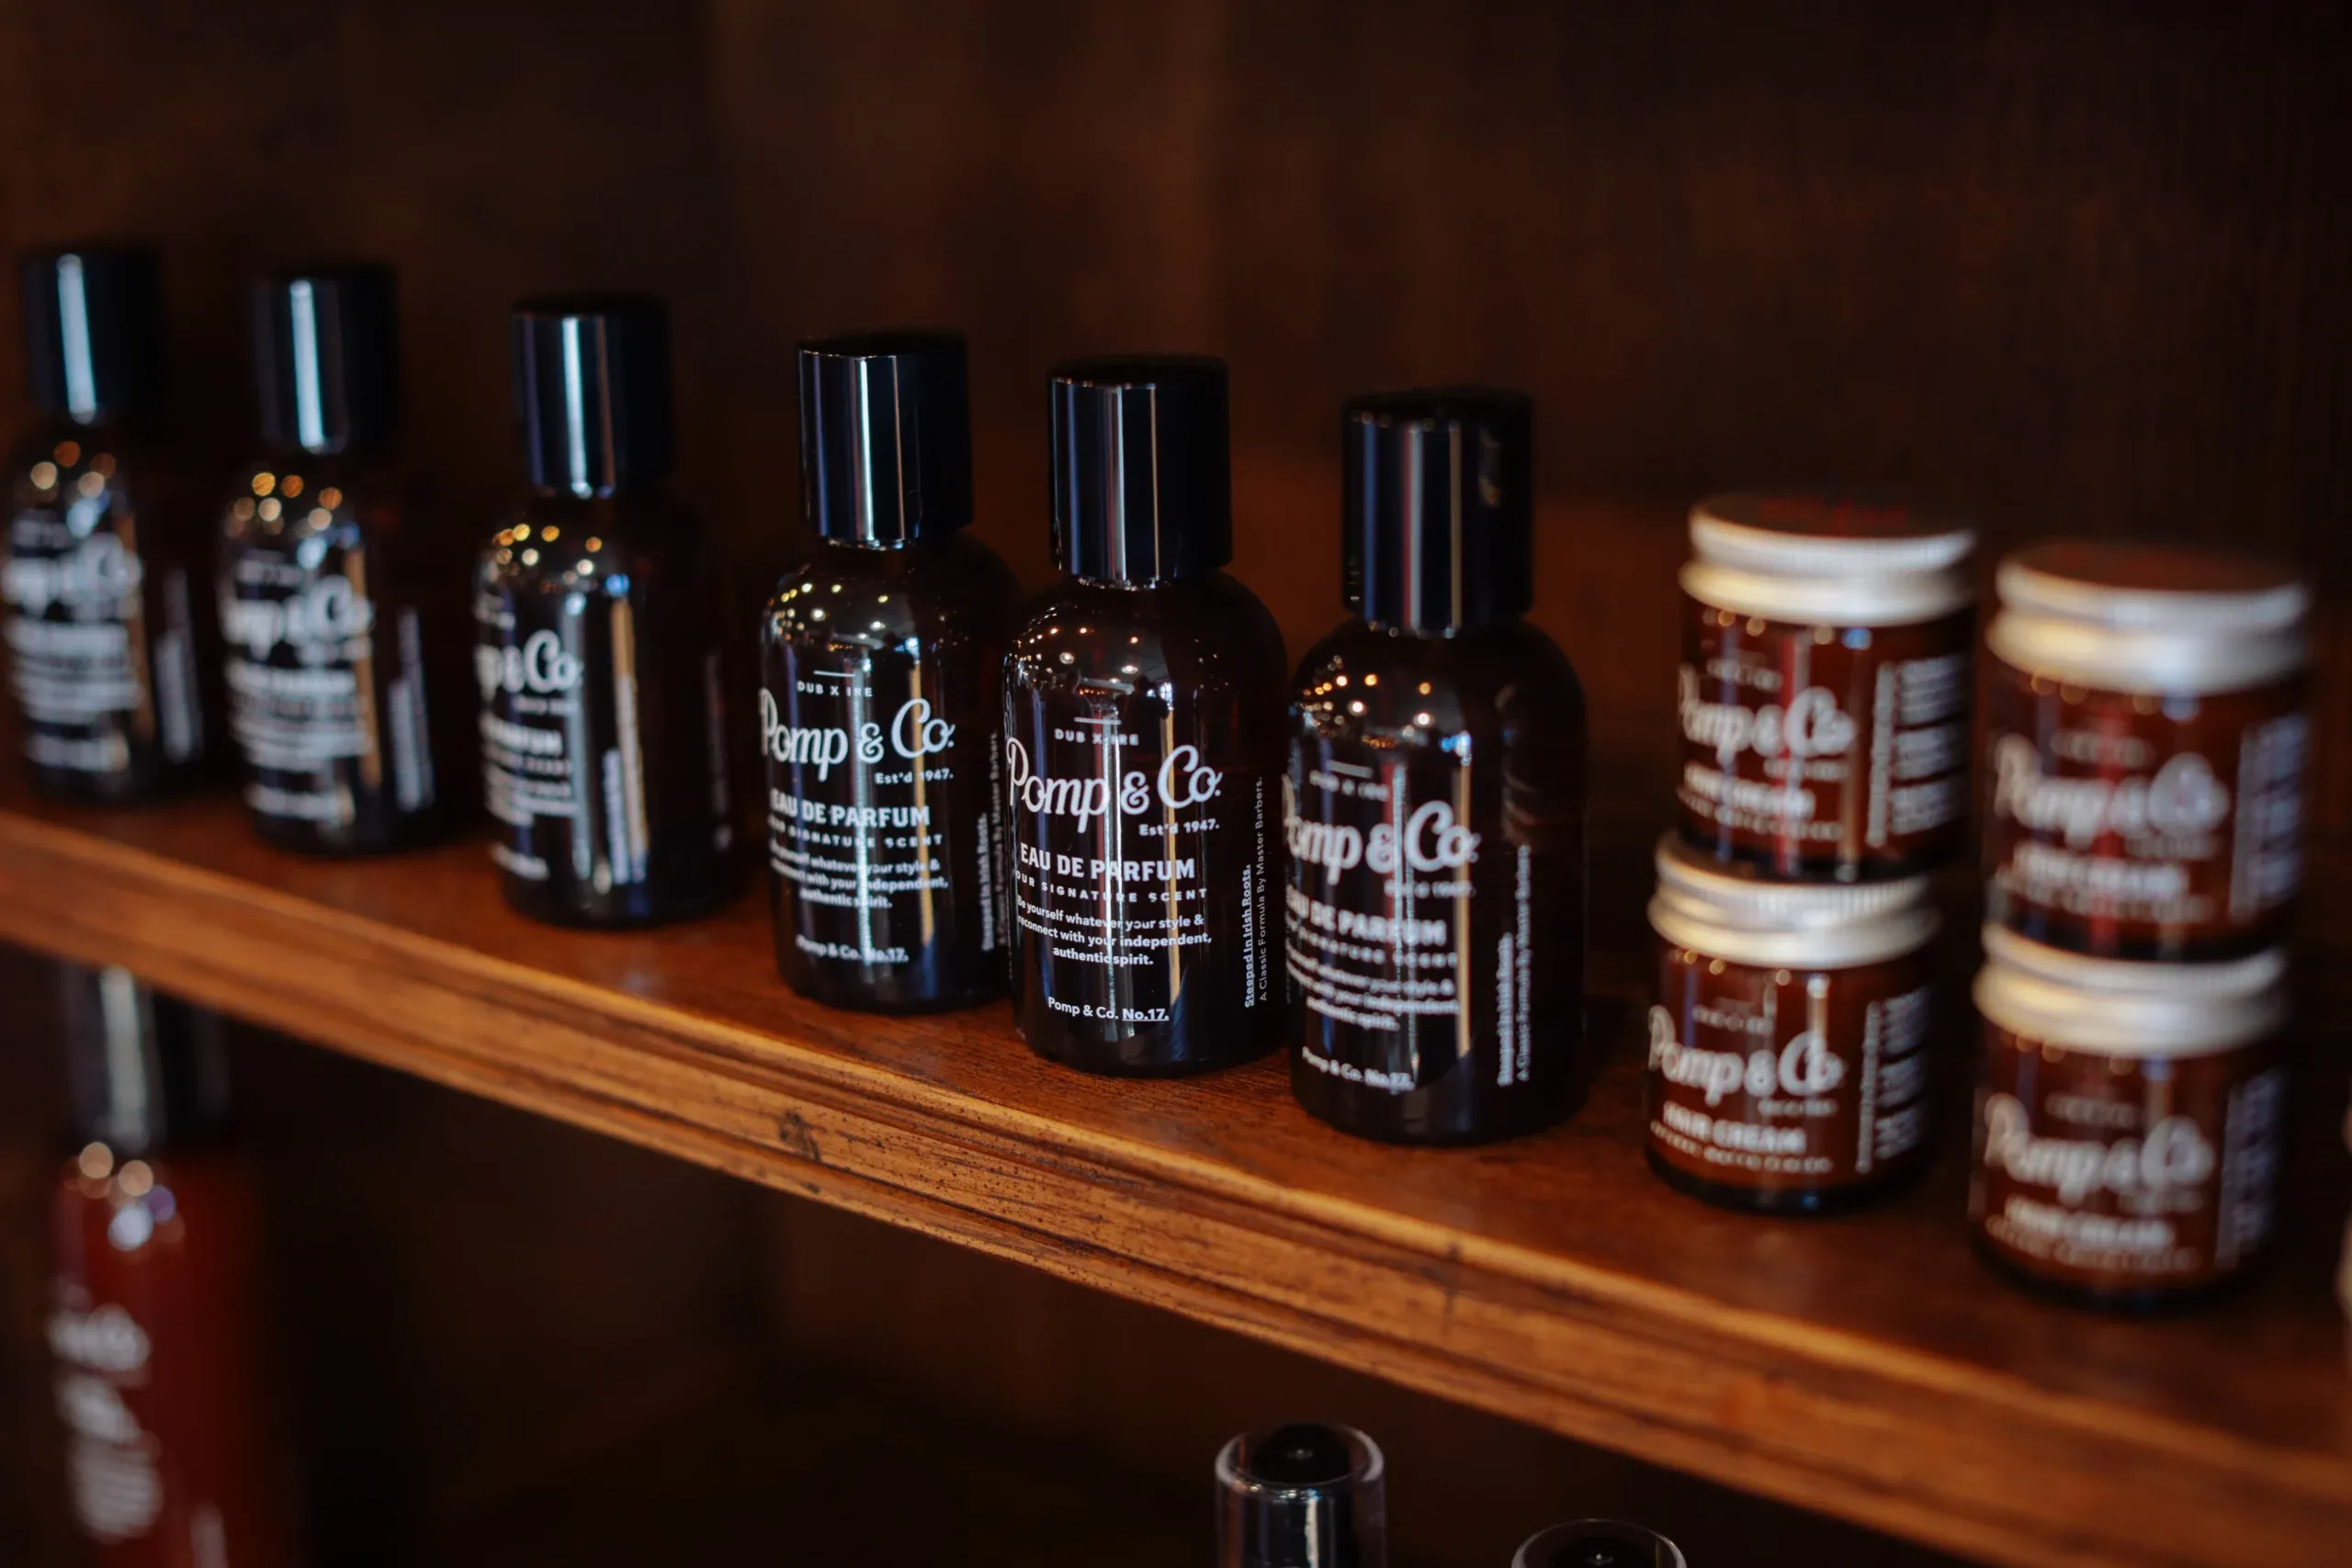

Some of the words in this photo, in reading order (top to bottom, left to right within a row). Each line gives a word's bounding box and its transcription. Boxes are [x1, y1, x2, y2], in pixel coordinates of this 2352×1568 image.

[797, 681, 824, 695] DUB
[830, 686, 840, 696] X
[845, 686, 874, 697] IRE
[759, 687, 848, 782] Pomp
[858, 722, 884, 763] &
[891, 698, 956, 758] Co.
[1055, 728, 1086, 743] DUB
[1092, 734, 1102, 744] X
[1006, 737, 1111, 833] Pomp
[1120, 771, 1150, 816] &
[1157, 744, 1223, 809] Co.
[1255, 775, 1263, 830] Barbers.
[770, 788, 797, 817] EAU
[802, 799, 827, 824] DE
[830, 805, 931, 828] PARFUM
[884, 834, 943, 848] SCENT
[1139, 823, 1179, 837] Est'd
[1183, 818, 1220, 833] 1947.
[929, 858, 940, 871] &
[1021, 841, 1051, 871] EAU
[1057, 853, 1084, 878] DE
[1090, 858, 1195, 882] PARFUM
[1256, 831, 1264, 875] Master
[1015, 870, 1035, 887] OUR
[1041, 881, 1138, 903] SIGNATURE
[1148, 887, 1207, 903] SCENT
[1241, 864, 1251, 907] Roots.
[1256, 877, 1267, 894] By
[1016, 894, 1026, 909] Be
[1026, 899, 1064, 922] yourself
[1065, 912, 1124, 929] whatever
[1125, 919, 1156, 932] your
[1159, 914, 1192, 930] style
[1193, 913, 1204, 926] &
[1242, 908, 1253, 937] Irish
[1257, 895, 1266, 946] Formula
[1017, 913, 1058, 939] reconnect
[1059, 930, 1086, 943] with
[1087, 934, 1117, 948] your
[1120, 932, 1213, 951] independent,
[1243, 938, 1253, 953] In
[1053, 946, 1112, 964] authentic
[1113, 953, 1154, 967] spirit.
[1259, 946, 1267, 990] Classic
[1244, 953, 1255, 1009] Steeped
[1260, 991, 1267, 1001] A
[1047, 996, 1080, 1017] Pomp
[1082, 1004, 1093, 1017] &
[1096, 1006, 1119, 1020] Co.
[1122, 1008, 1170, 1022] No.17.
